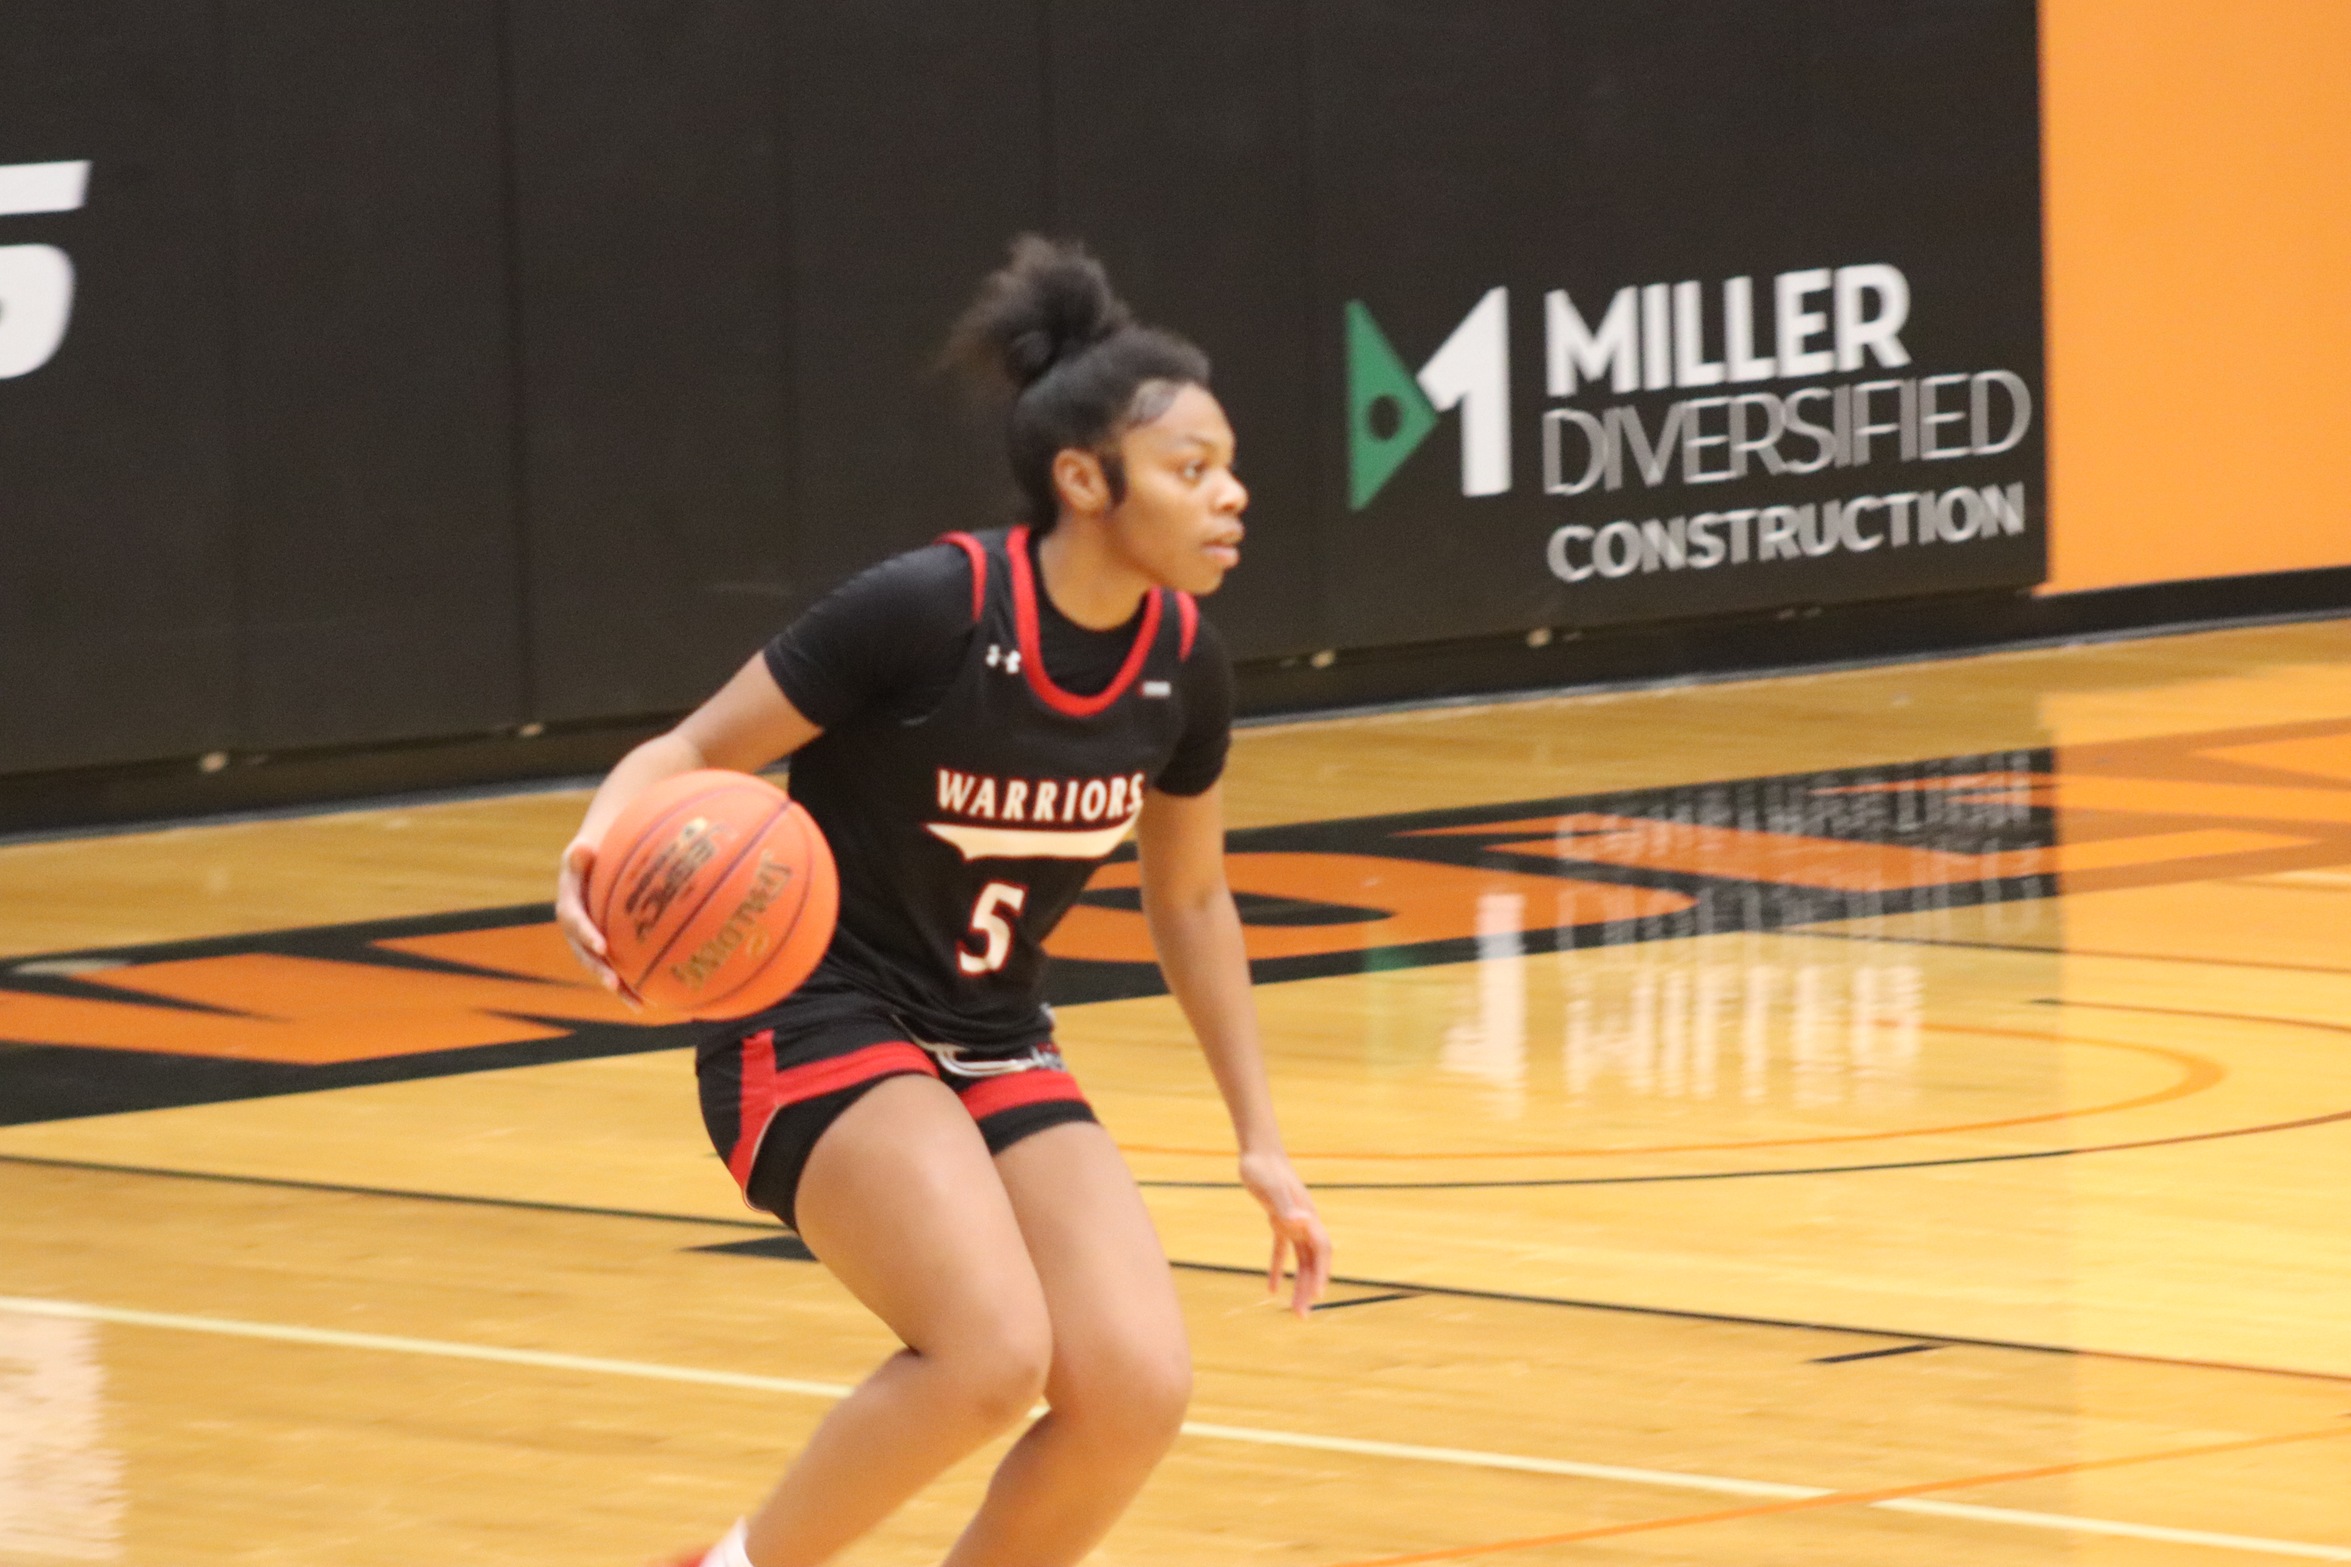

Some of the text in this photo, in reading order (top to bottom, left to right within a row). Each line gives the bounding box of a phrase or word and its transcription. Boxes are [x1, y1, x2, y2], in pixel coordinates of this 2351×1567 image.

[1545, 263, 1911, 397] MILLER
[1543, 369, 2032, 495] DIVERSIFIED
[1546, 482, 2026, 583] CONSTRUCTION
[937, 768, 1145, 823] WARRIORS
[957, 881, 1027, 975] 5
